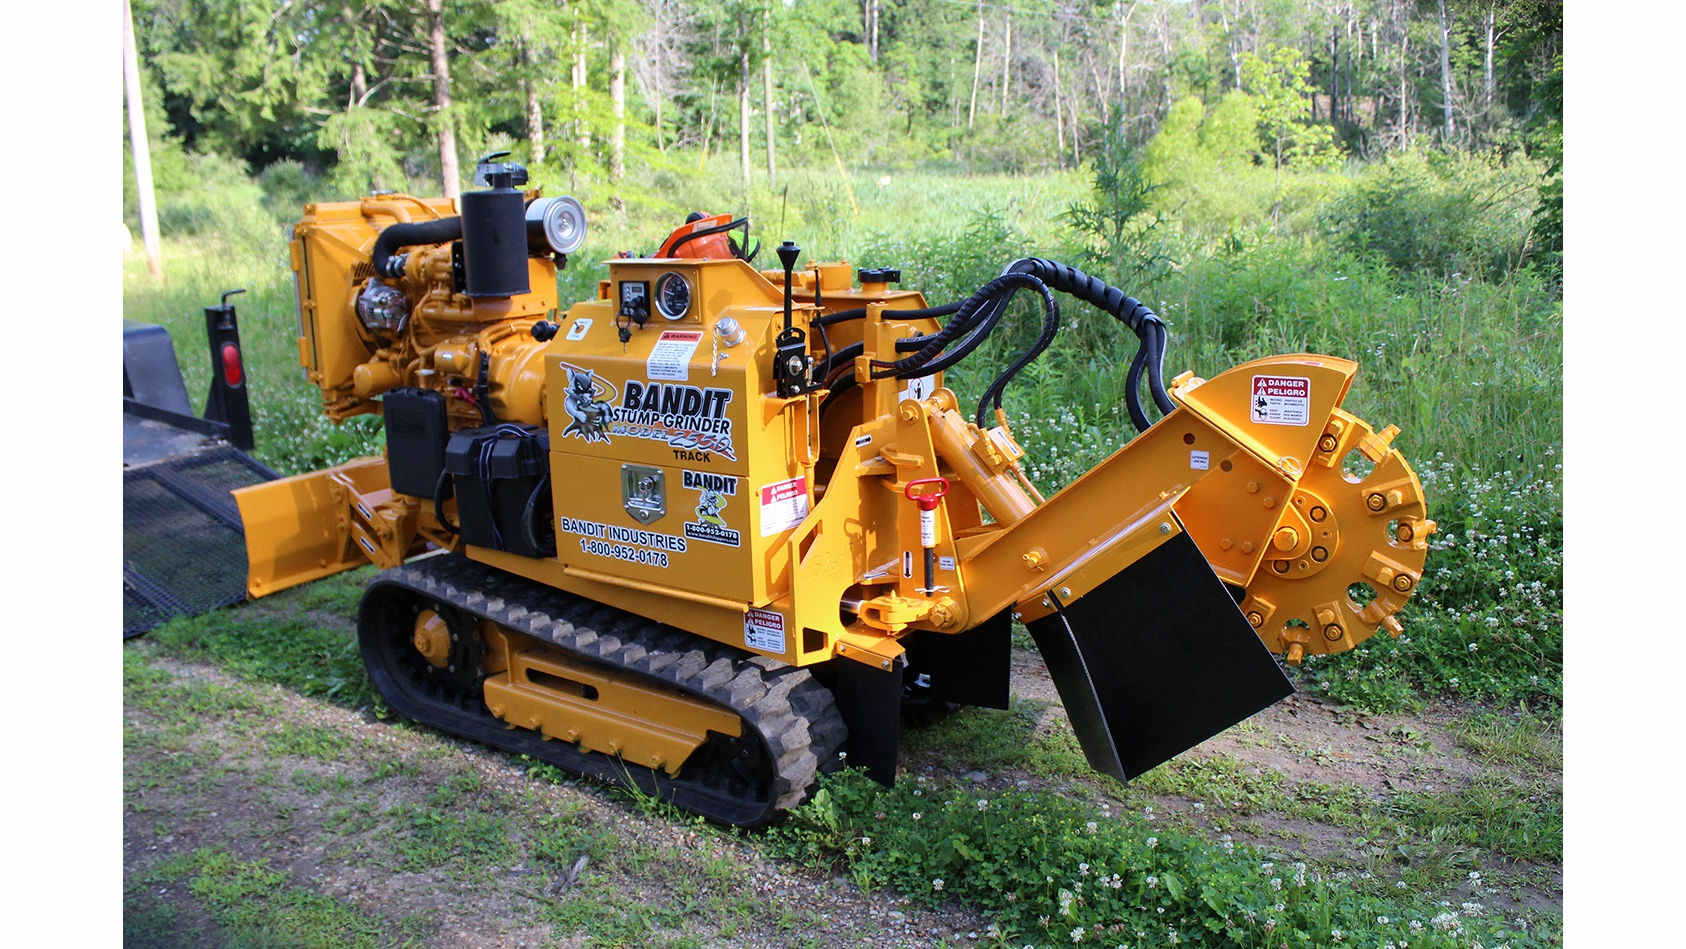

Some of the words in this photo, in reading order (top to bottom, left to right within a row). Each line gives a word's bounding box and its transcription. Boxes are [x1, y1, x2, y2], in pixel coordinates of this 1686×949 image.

[1268, 380, 1304, 388] DANGER
[1267, 388, 1306, 397] PELIGRO
[624, 382, 731, 419] BANDIT
[612, 408, 660, 427] STUMP
[663, 414, 730, 435] GRINDER
[611, 424, 669, 440] MODEL
[669, 432, 731, 453] 2550
[672, 450, 711, 462] TRACK
[683, 471, 737, 494] BANDIT
[776, 481, 797, 492] DANGER
[776, 489, 798, 500] PELIGRO
[561, 518, 606, 538] BANDIT
[608, 526, 686, 552] INDUSTRIES
[686, 524, 738, 539] 1-800-952-0178
[580, 539, 668, 567] 1-800-952-0178
[754, 611, 780, 622] DANGER
[754, 619, 782, 629] PELIGRO
